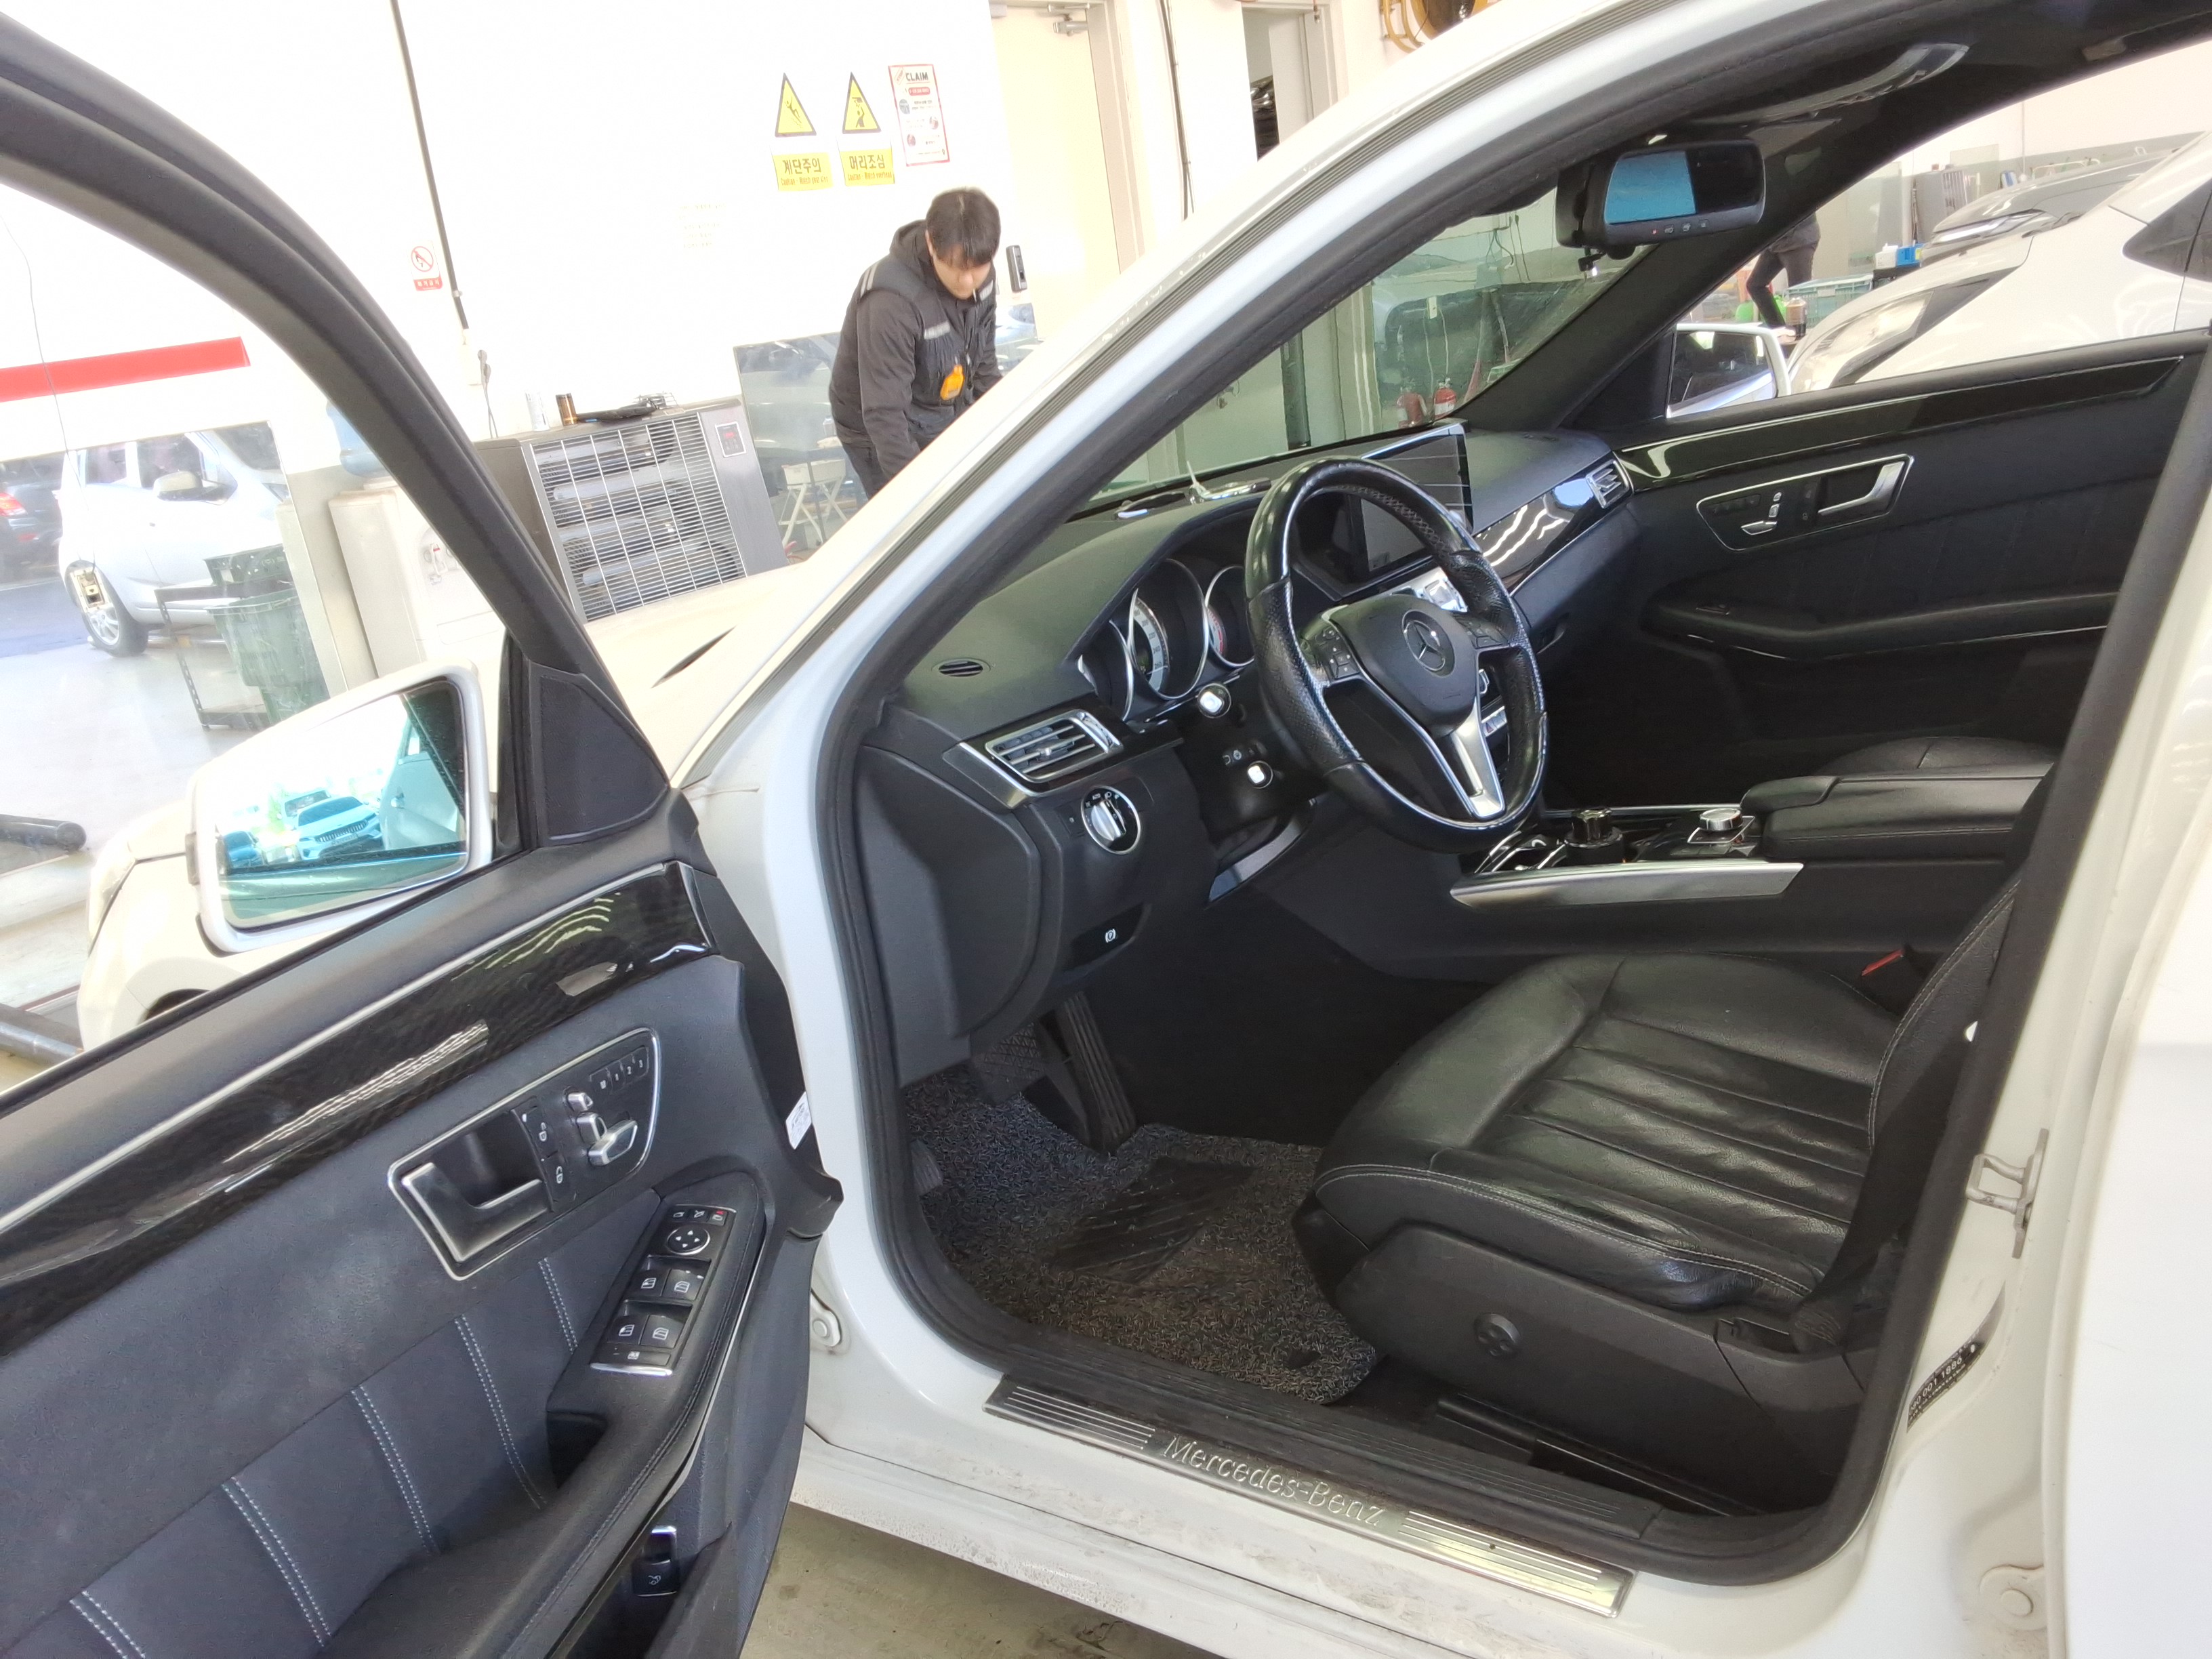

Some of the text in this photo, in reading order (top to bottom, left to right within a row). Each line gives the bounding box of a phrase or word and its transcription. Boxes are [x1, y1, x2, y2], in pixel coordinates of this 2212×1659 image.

[905, 72, 929, 81] CLAIM
[782, 158, 821, 175] 계단주의
[849, 155, 885, 169] 머리조심
[1923, 1377, 1938, 1397] 001
[1162, 1435, 1386, 1526] Mercedes-Benz
